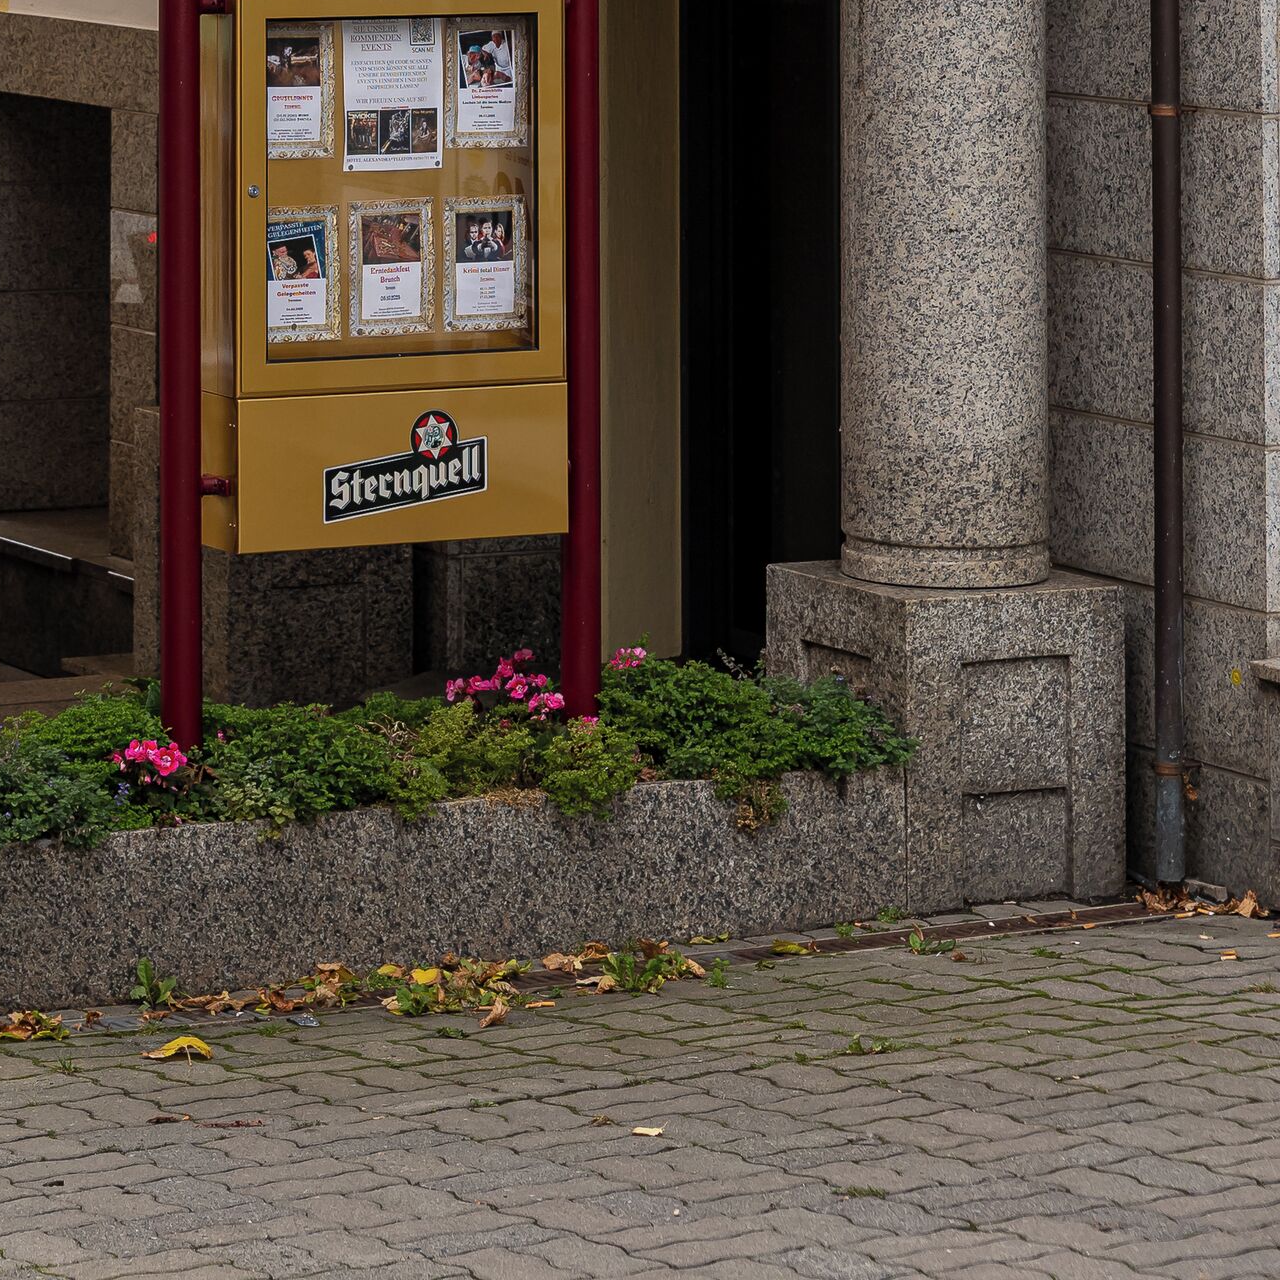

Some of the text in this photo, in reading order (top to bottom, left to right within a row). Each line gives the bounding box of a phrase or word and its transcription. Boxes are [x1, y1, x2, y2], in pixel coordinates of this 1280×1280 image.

[350, 33, 402, 43] KOMMENDEN
[361, 43, 392, 51] EVENTS
[329, 444, 481, 511] Sternquell
